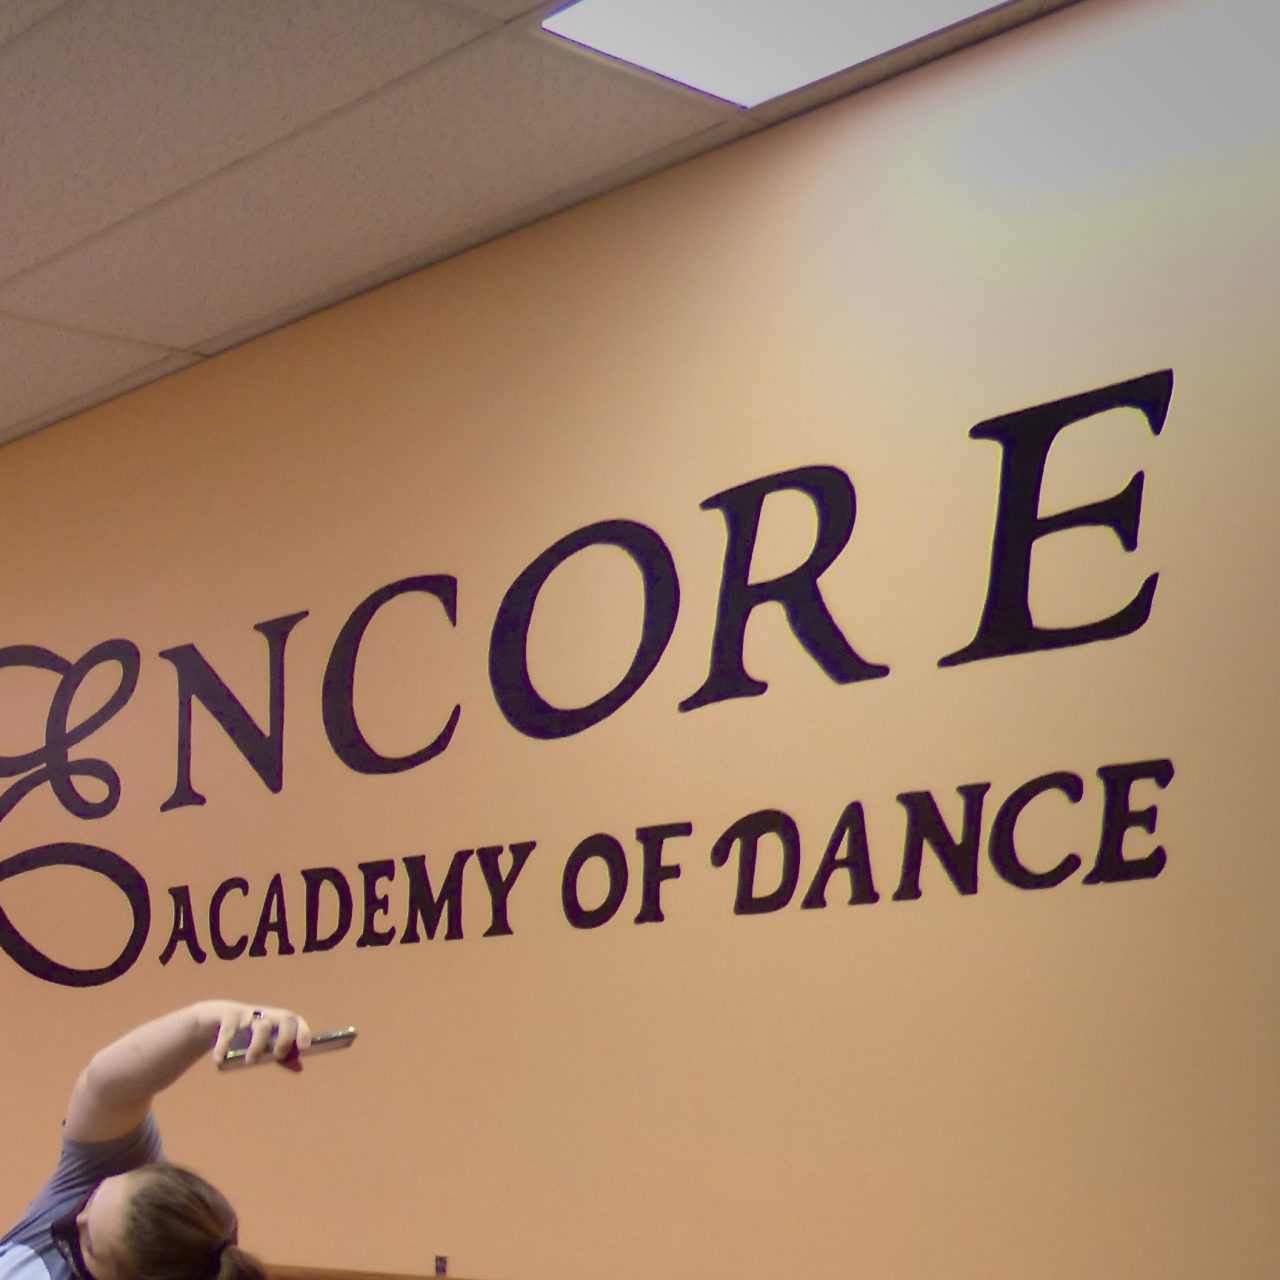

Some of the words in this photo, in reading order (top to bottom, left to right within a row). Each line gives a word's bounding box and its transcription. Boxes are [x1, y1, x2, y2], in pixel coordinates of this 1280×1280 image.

[158, 841, 537, 967] ACADEMY
[561, 822, 693, 930] OF
[711, 758, 1176, 916] DANCE
